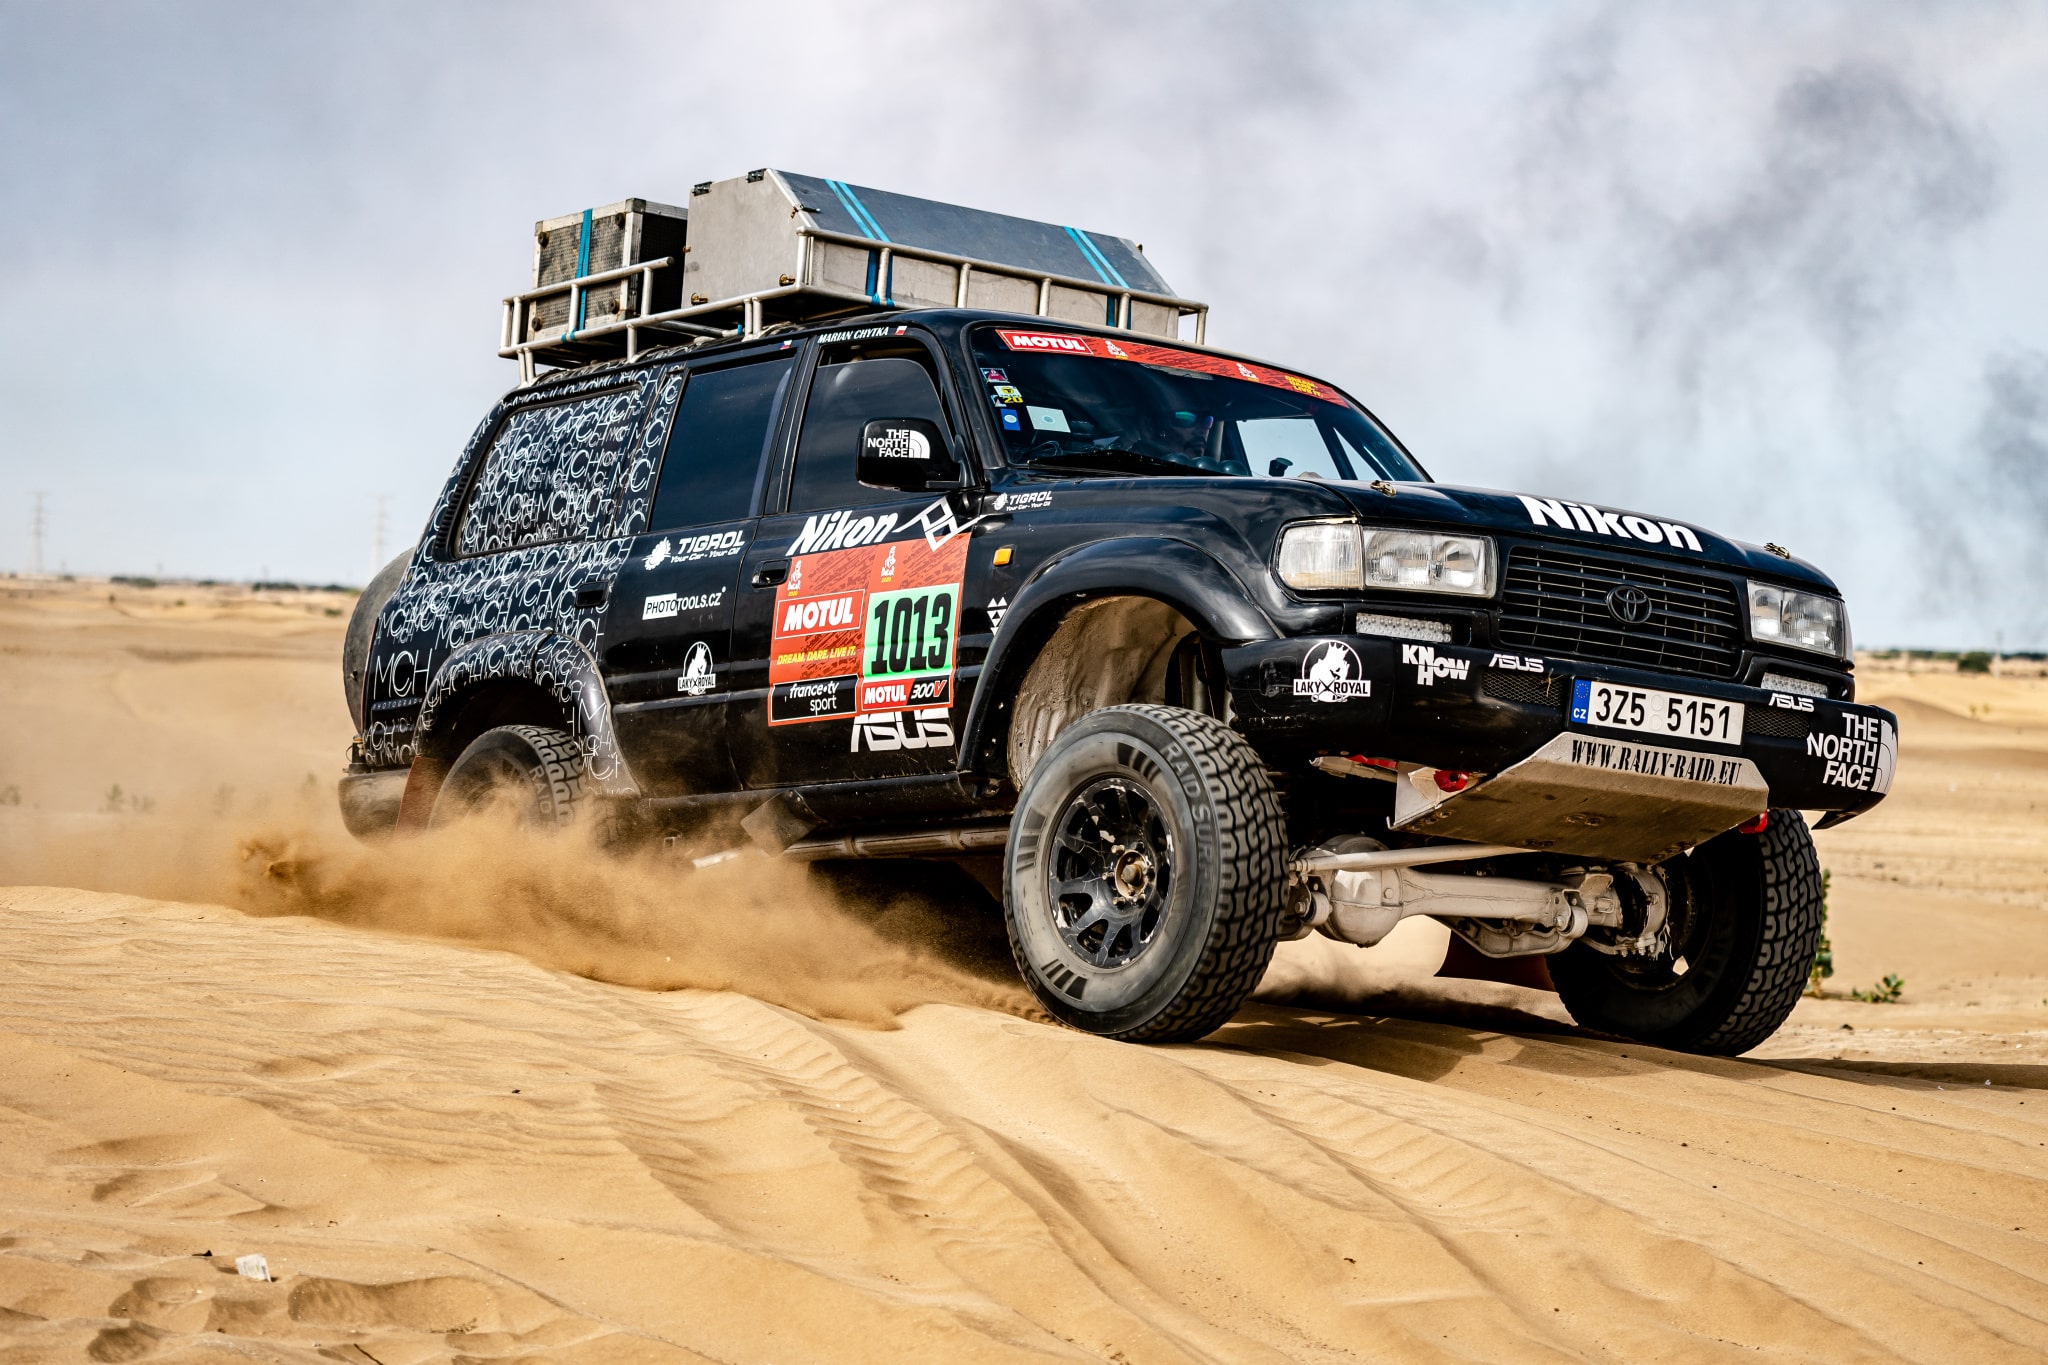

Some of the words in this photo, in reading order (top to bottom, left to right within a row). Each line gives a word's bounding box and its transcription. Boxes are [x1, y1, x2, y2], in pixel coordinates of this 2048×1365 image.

[817, 330, 853, 344] MARIAN
[853, 326, 890, 340] CHYTKA
[1011, 335, 1085, 351] MOTUL
[867, 437, 909, 448] NORTH
[886, 428, 910, 439] THE
[879, 447, 908, 458] FACE
[1010, 491, 1053, 505] TIGROL
[786, 510, 899, 556] Nikon
[1515, 494, 1703, 552] Nikon
[677, 530, 745, 554] TIGROL
[646, 592, 722, 614] PHOTOTOOLS.CZ
[783, 597, 853, 632] MOTUL
[871, 592, 951, 675] 1013
[777, 651, 805, 665] DREAM.
[806, 649, 829, 662] DARE.
[829, 647, 846, 659] LIVE
[846, 646, 857, 657] IT.
[1488, 653, 1544, 673] ASUS
[374, 648, 432, 700] MCH
[864, 684, 907, 704] MOTUL
[911, 680, 947, 700] 300V
[1295, 680, 1321, 693] LAKY
[1333, 680, 1369, 695] ROYAL
[810, 696, 837, 716] sport
[1573, 708, 1587, 720] CZ
[1595, 688, 1646, 727] 3Z5
[1667, 698, 1731, 739] 5151
[1769, 693, 1814, 713] ASUS
[850, 707, 955, 753] ASUS
[1842, 712, 1879, 742] THE
[1807, 732, 1878, 767] NORTH
[1572, 740, 1742, 785] WWW.RALLY-RAID.EU
[1823, 760, 1873, 792] FACE
